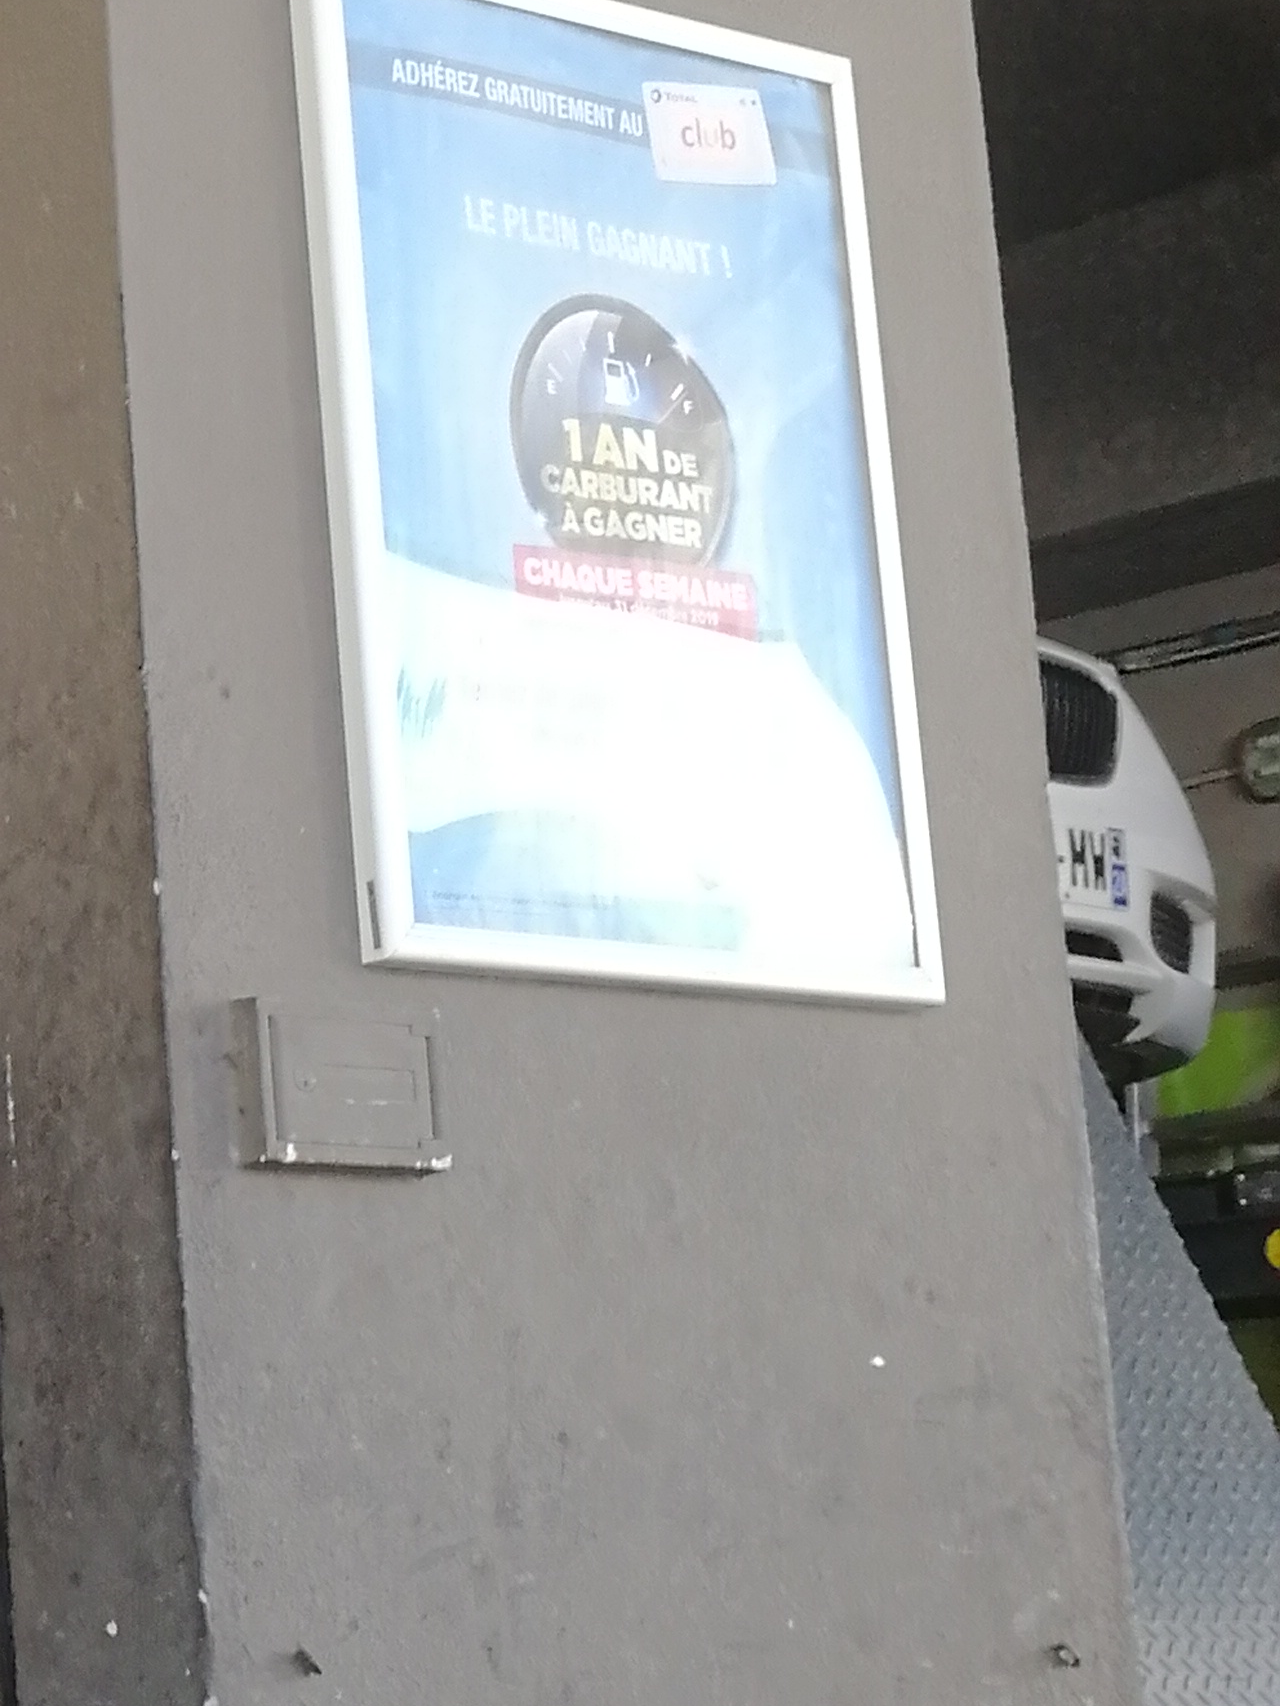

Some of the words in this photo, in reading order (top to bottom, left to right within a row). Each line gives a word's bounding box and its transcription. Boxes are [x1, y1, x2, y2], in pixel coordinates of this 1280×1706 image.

[391, 57, 481, 99] ADHÉREZ
[484, 76, 616, 131] GRATUITEMENT
[619, 108, 645, 138] AU
[681, 117, 737, 151] club
[463, 193, 497, 236] LE
[502, 200, 581, 252] PLEIN
[586, 219, 712, 277] GAGNANT
[561, 417, 584, 463] 1
[592, 422, 660, 474] AN
[662, 449, 700, 478] DE
[540, 462, 714, 515] CARBURANT
[582, 506, 703, 549] GAGNER
[522, 555, 635, 598] CHAQUE
[637, 568, 749, 612] SEMAINE
